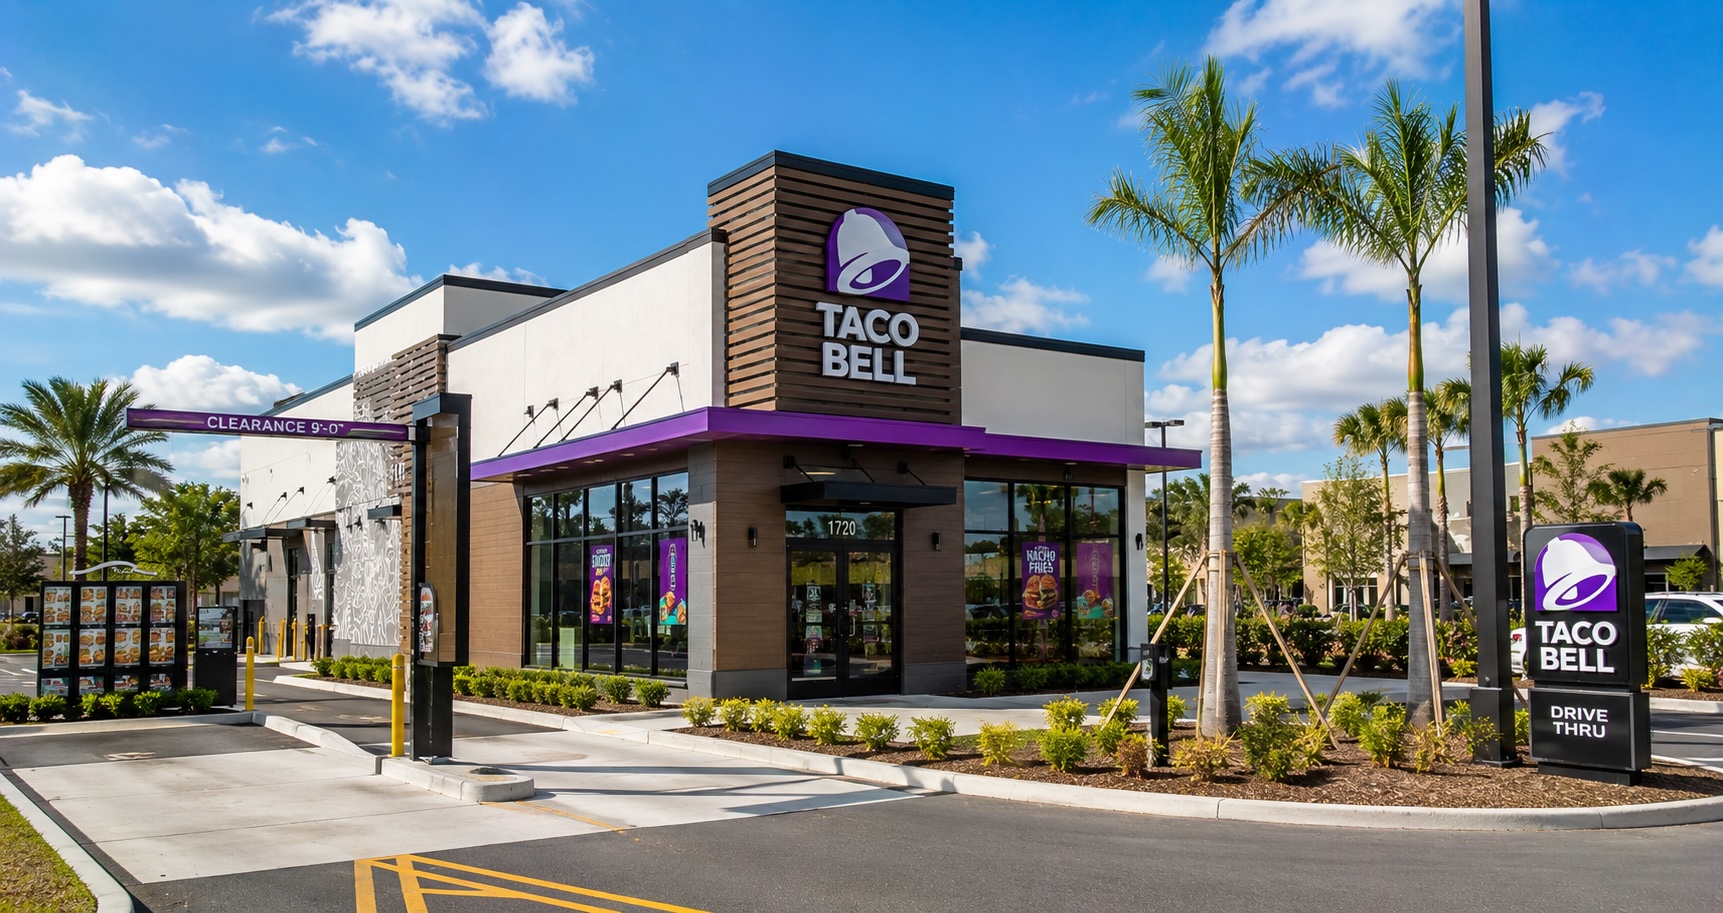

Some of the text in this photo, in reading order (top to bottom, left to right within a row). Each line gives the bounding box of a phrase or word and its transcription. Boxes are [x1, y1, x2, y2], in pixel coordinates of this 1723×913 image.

[815, 301, 920, 348] TACO
[822, 341, 917, 386] BELL
[206, 416, 306, 433] CLEARANCE
[828, 520, 857, 536] 1720
[1535, 621, 1617, 645] TACO
[1541, 646, 1615, 673] BELL
[1550, 705, 1609, 723] DRIVE
[1552, 722, 1605, 738] THRU
